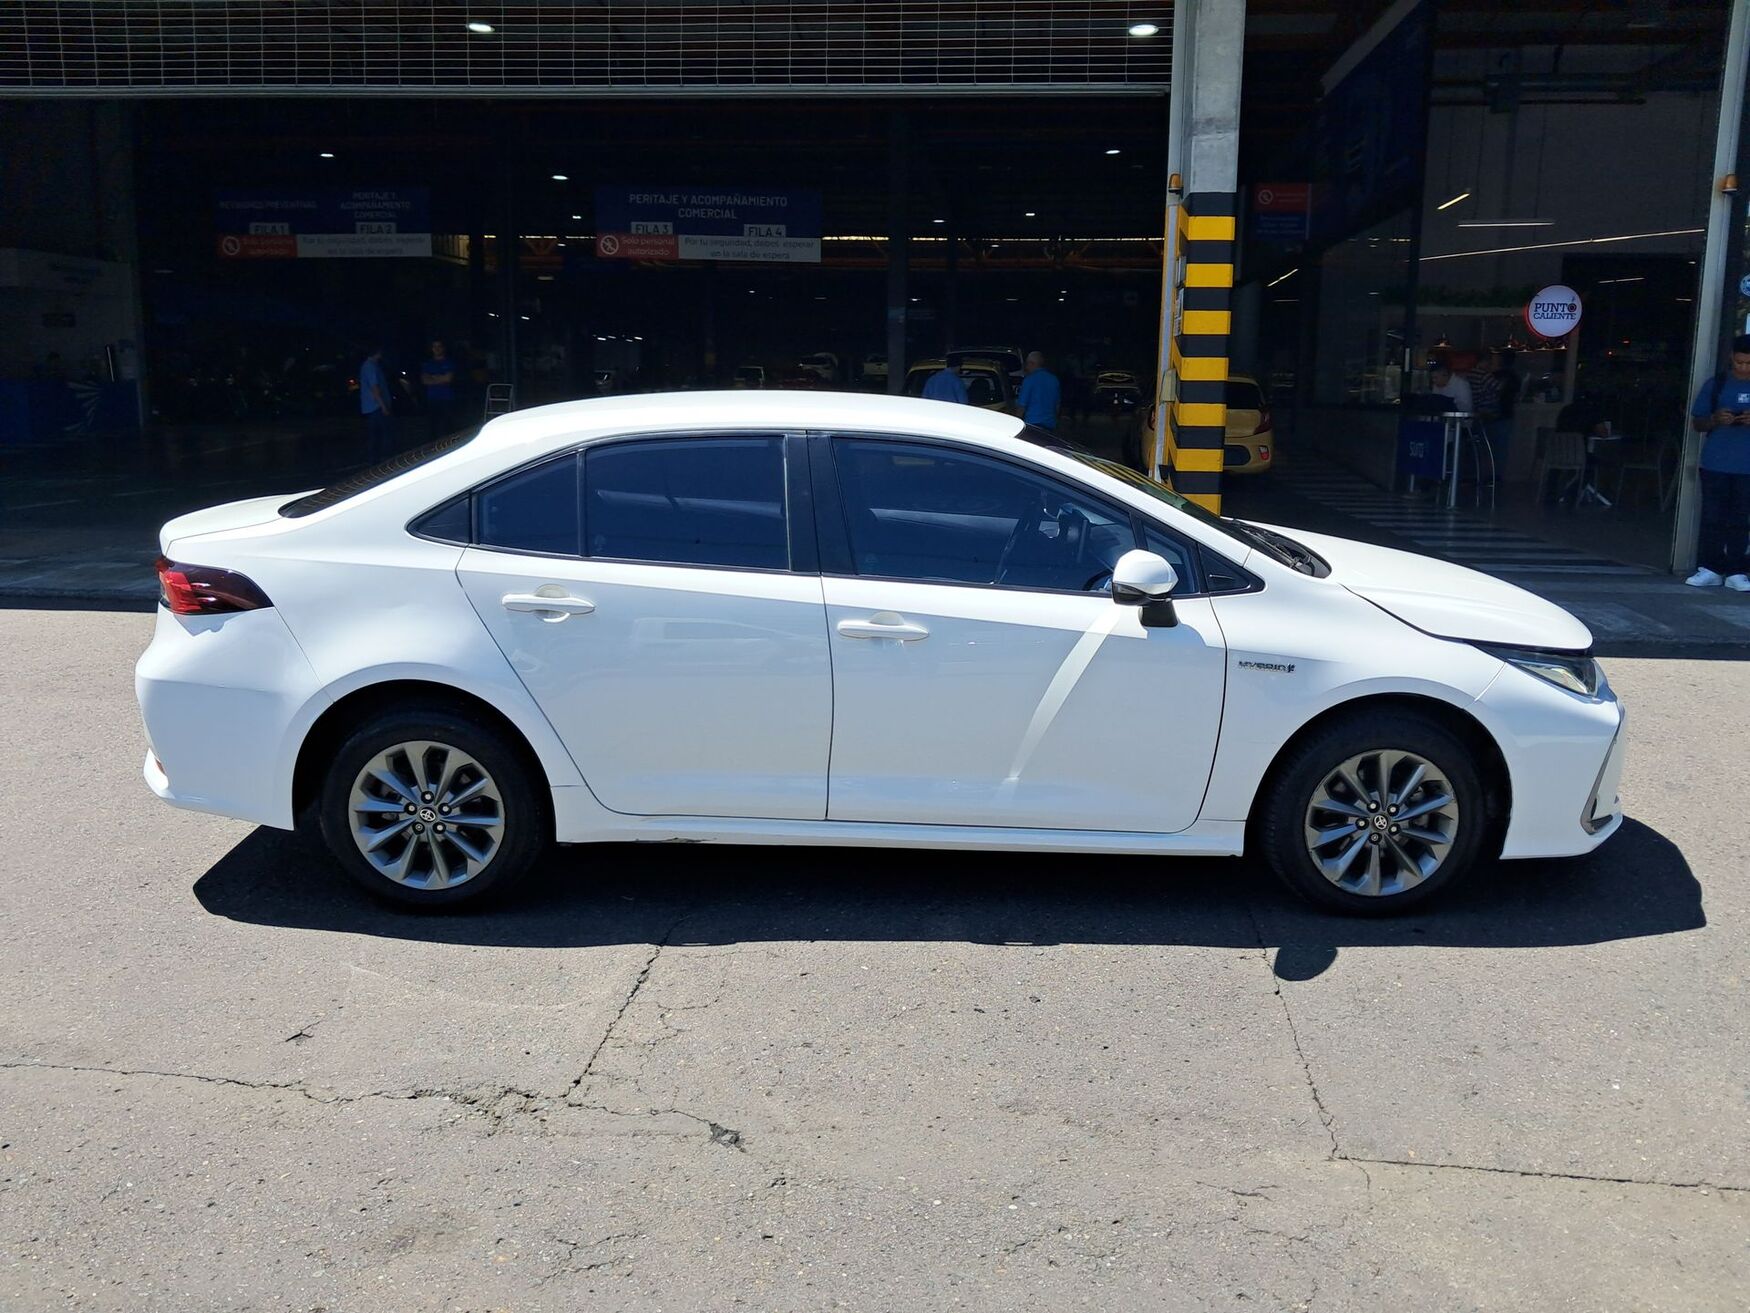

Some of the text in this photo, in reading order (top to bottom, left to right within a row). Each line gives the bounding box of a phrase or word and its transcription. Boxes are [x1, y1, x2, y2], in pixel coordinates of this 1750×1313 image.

[629, 193, 788, 207] PERITAJE Y ACOMPAÑAMIENTO
[678, 207, 737, 219] COMERCIAL
[255, 225, 277, 233] FILA
[360, 224, 392, 233] FILA 2
[635, 225, 669, 234] FILA 3
[748, 226, 782, 237] FILA 4
[1534, 303, 1577, 312] PUNTO
[1533, 312, 1577, 320] CALIENTE
